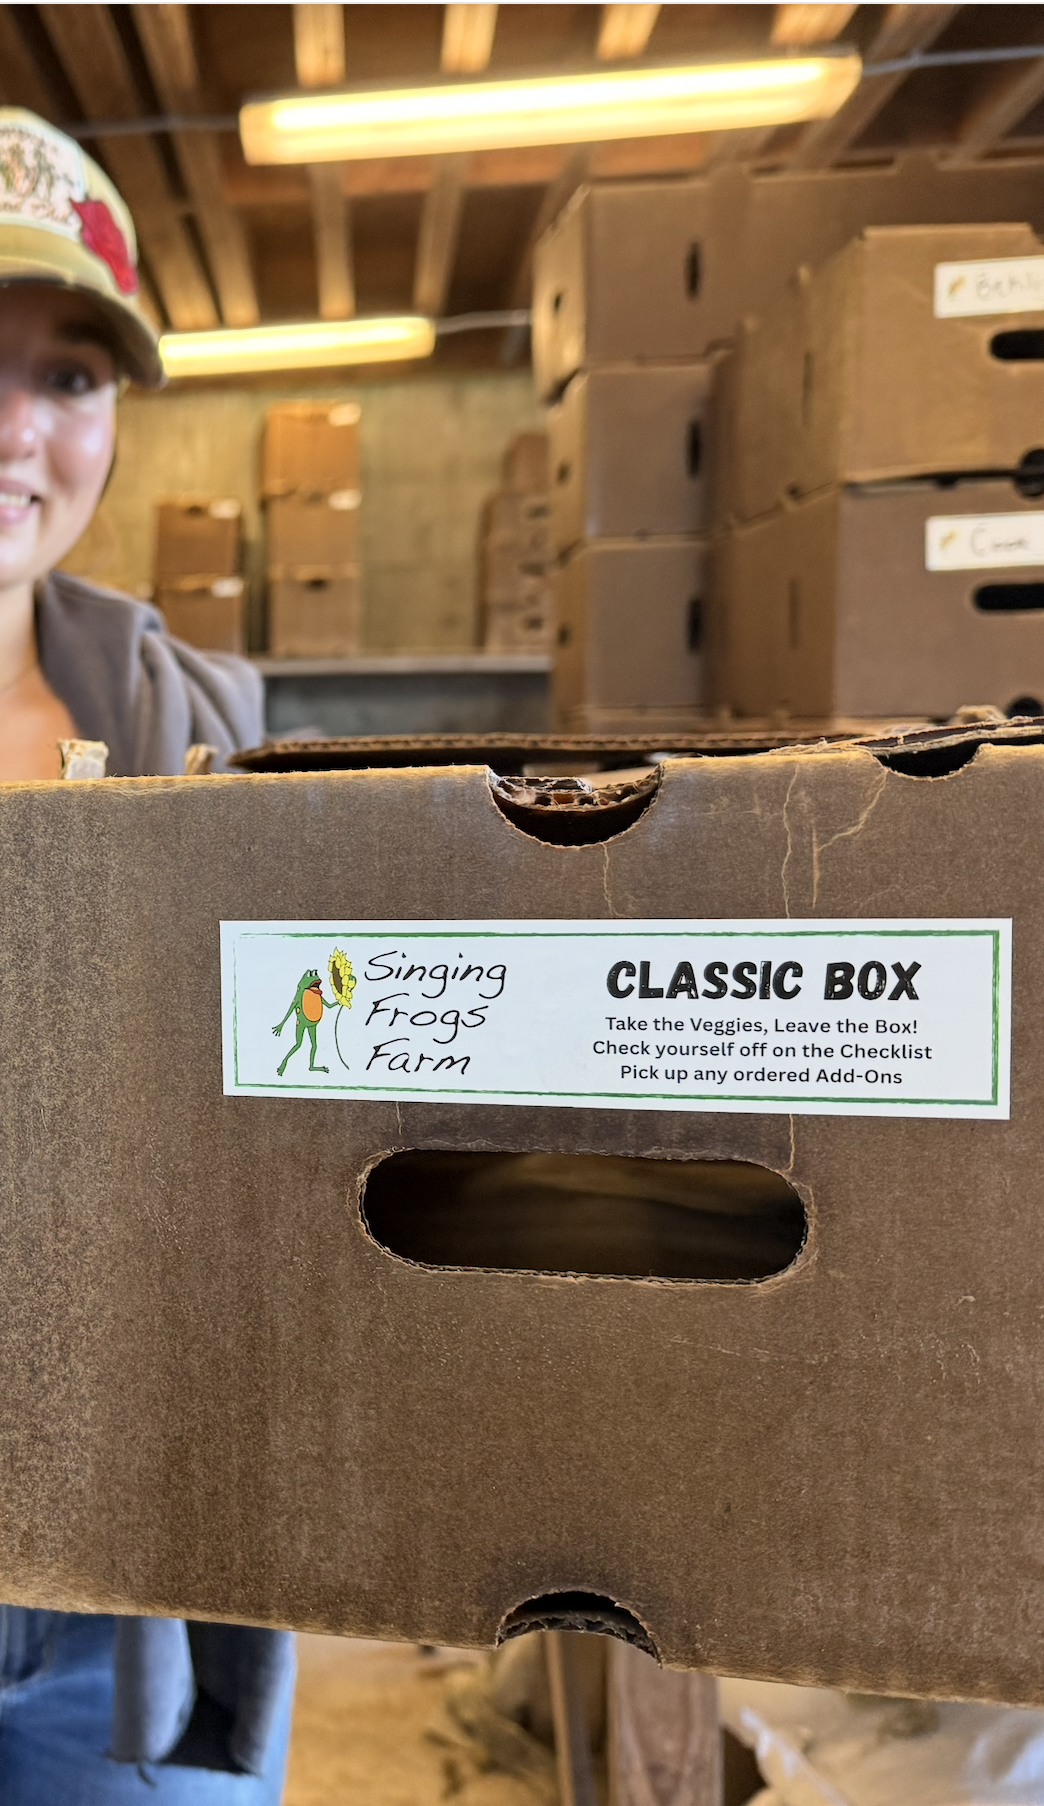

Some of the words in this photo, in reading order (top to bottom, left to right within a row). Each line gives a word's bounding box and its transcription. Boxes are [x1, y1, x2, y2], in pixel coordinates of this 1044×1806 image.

[364, 950, 507, 1000] Singing
[606, 960, 804, 1000] CLASSIC
[823, 960, 922, 1001] BOX
[364, 992, 490, 1045] Frogs
[605, 1016, 648, 1031] Take
[652, 1016, 685, 1032] the
[689, 1017, 768, 1036] Veggies,
[774, 1018, 831, 1033] Leave
[835, 1018, 869, 1034] the
[875, 1019, 917, 1034] Box!
[365, 1037, 471, 1076] Farm
[592, 1040, 651, 1055] Check
[654, 1041, 735, 1060] yourself
[739, 1042, 768, 1057] off
[772, 1046, 796, 1058] on
[801, 1043, 835, 1058] the
[840, 1043, 933, 1060] Checklist
[621, 1065, 659, 1080] Pick
[664, 1069, 688, 1084] up
[693, 1069, 728, 1085] any
[733, 1066, 810, 1083] ordered
[815, 1068, 903, 1084] Add-Ons
